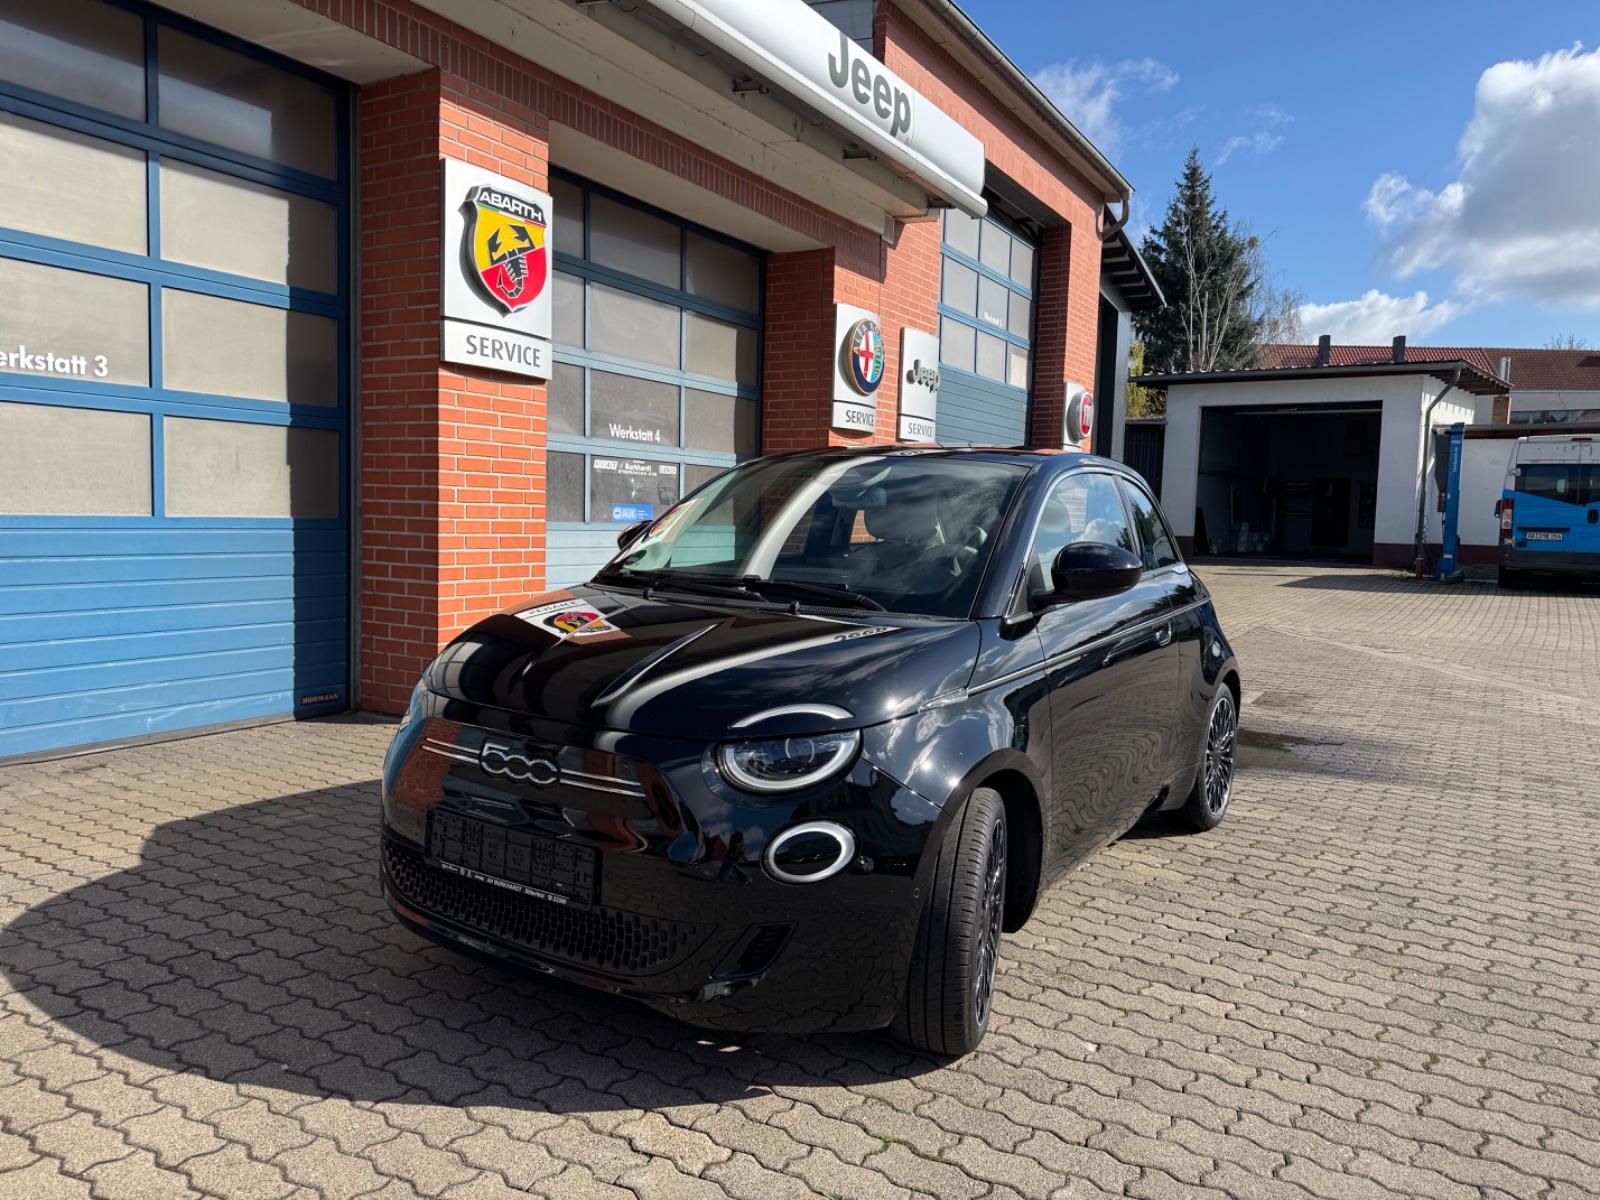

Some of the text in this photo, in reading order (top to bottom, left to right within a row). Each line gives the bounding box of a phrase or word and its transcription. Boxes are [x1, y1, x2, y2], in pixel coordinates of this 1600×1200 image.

[827, 30, 912, 137] Jeep
[479, 191, 543, 222] ABARTH
[465, 334, 541, 368] SERVICE
[94, 354, 108, 377] 3
[845, 409, 874, 427] SERVICE
[908, 422, 934, 438] SERVICE
[608, 423, 661, 443] Werkstatt 4
[481, 742, 558, 784] 500
